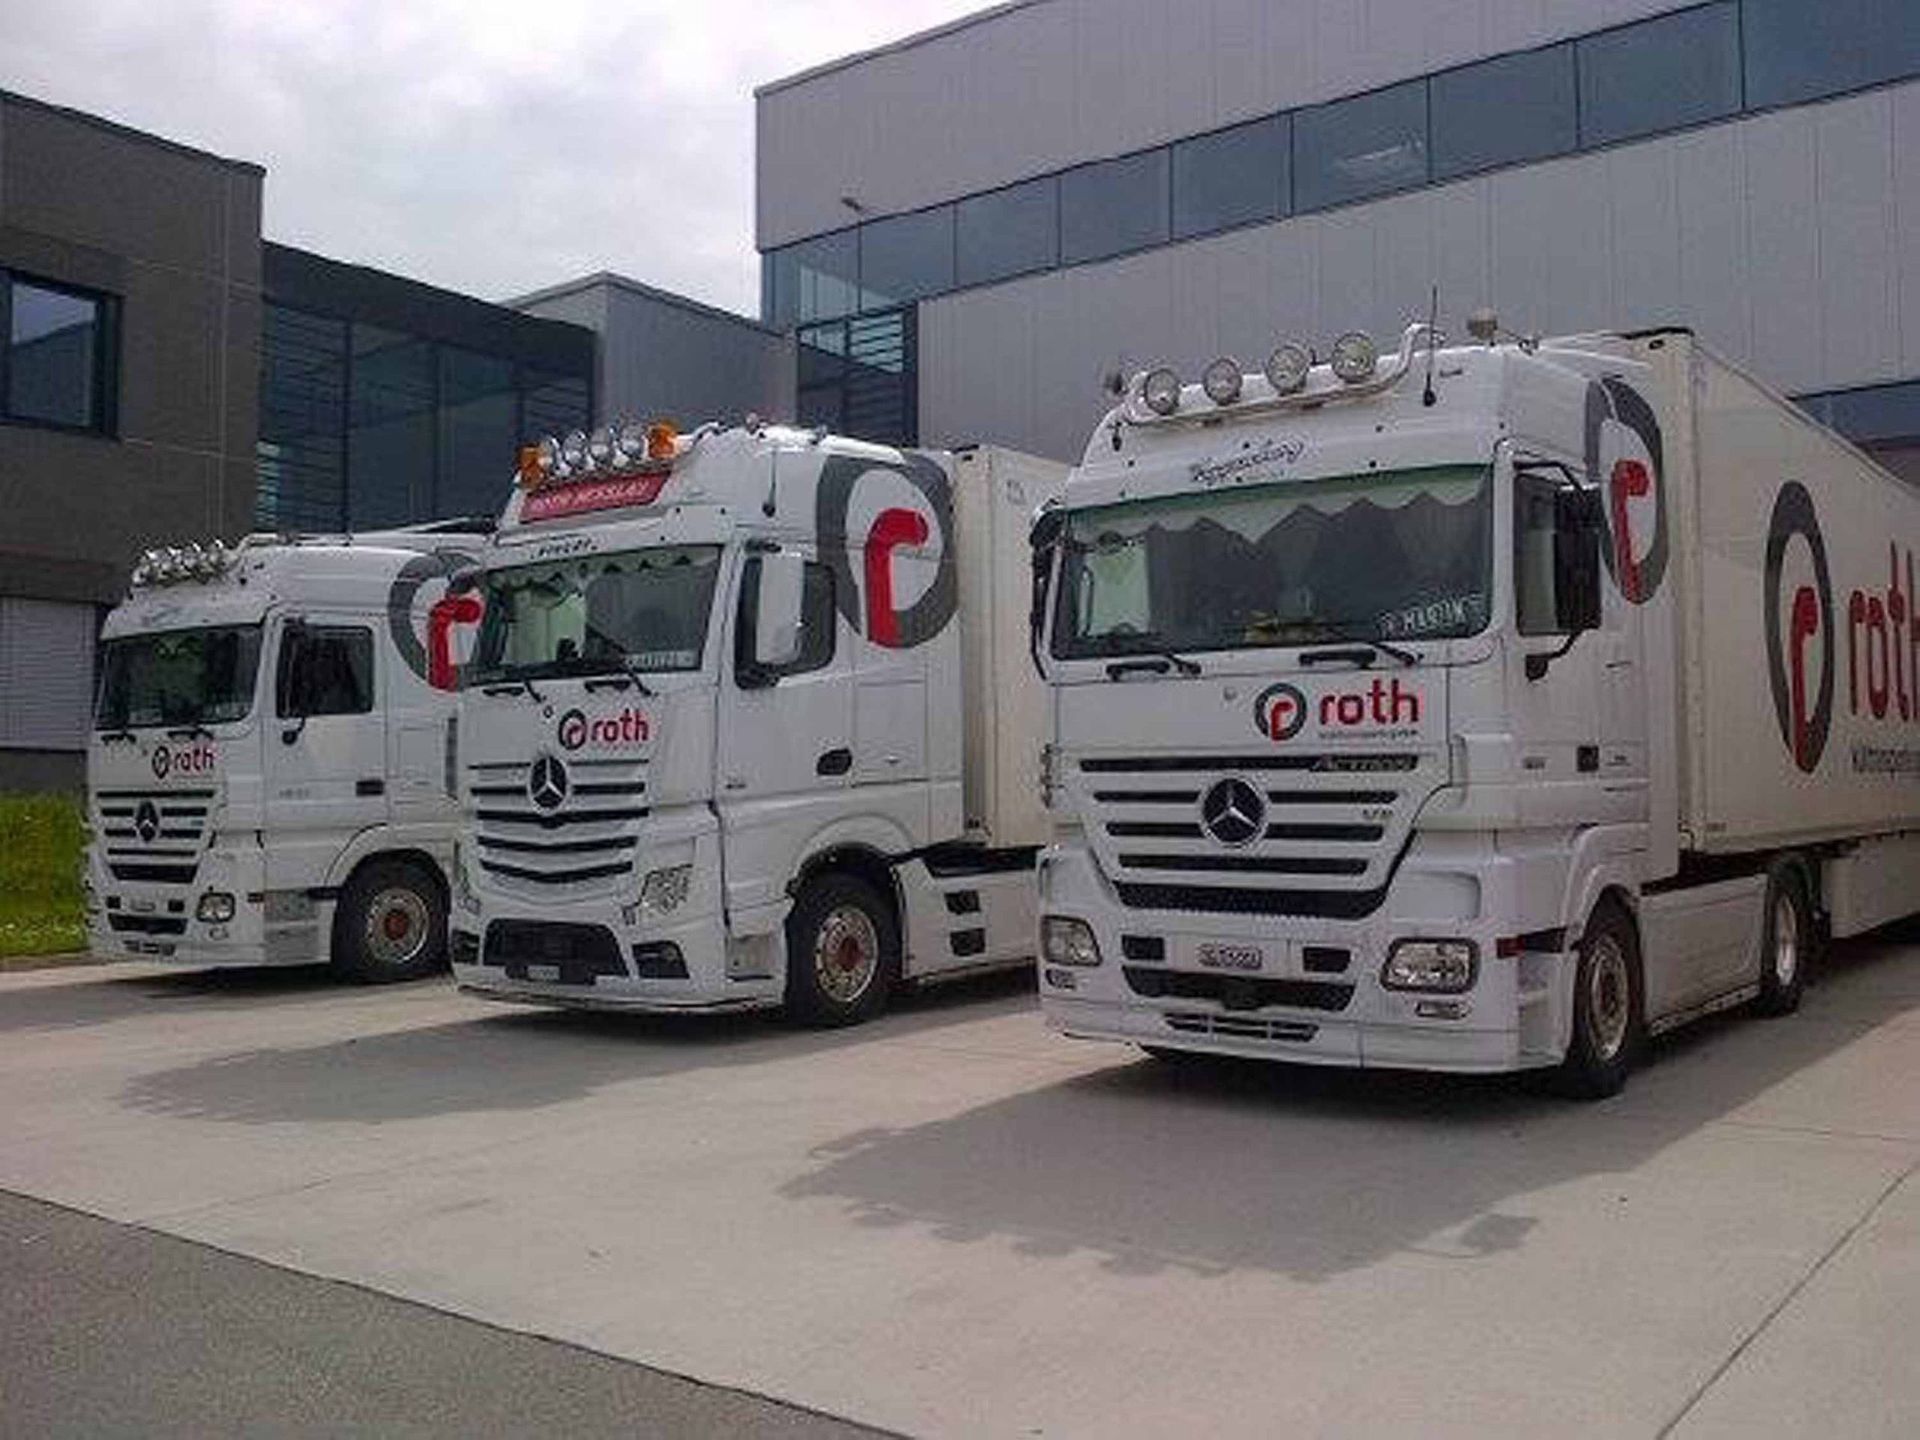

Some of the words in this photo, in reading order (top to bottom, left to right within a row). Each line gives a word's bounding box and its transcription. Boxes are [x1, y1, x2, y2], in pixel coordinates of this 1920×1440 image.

[1319, 679, 1419, 726] roth
[591, 707, 649, 741] roth
[174, 747, 214, 772] roth
